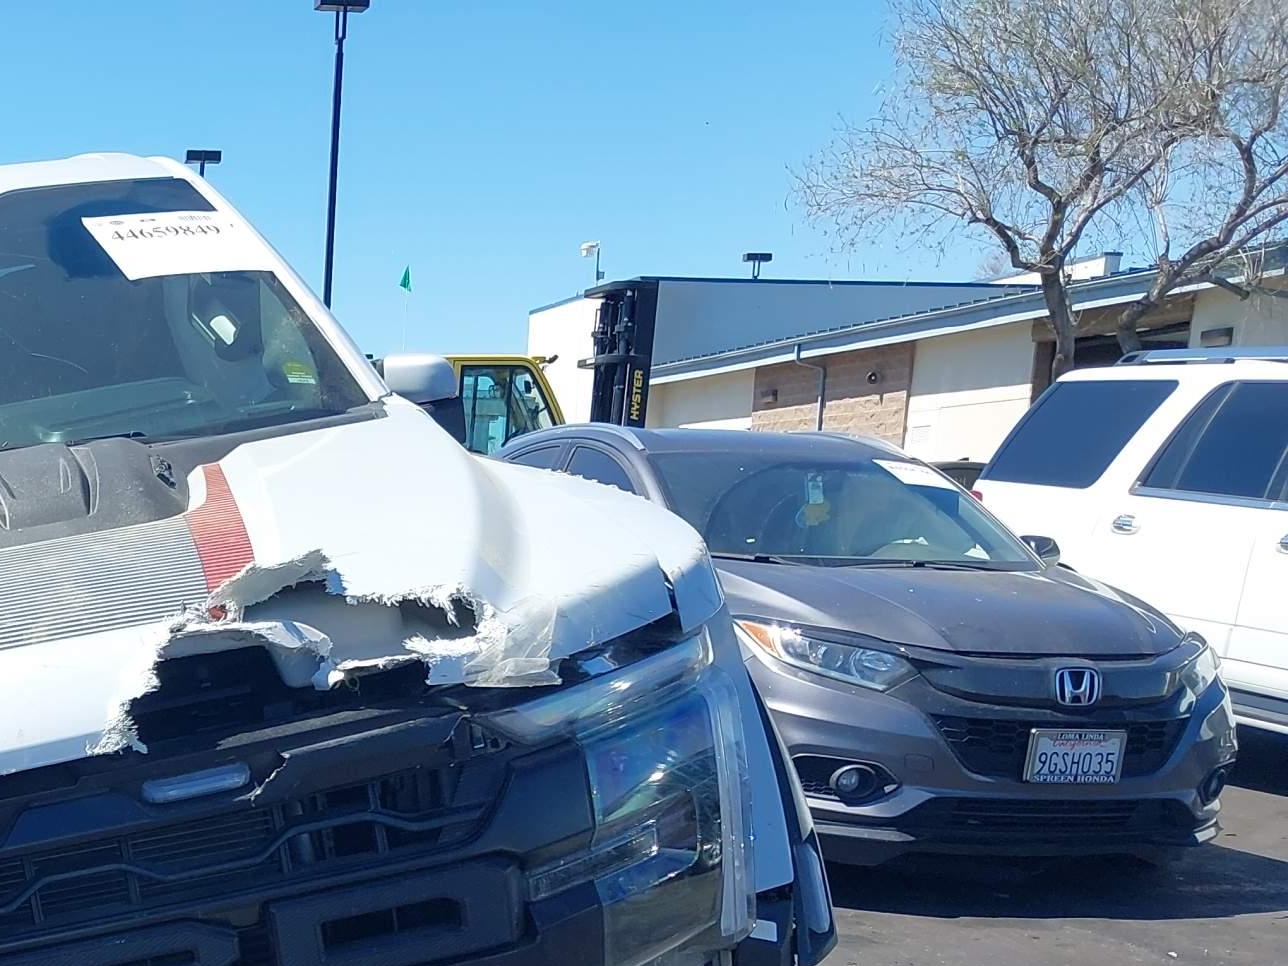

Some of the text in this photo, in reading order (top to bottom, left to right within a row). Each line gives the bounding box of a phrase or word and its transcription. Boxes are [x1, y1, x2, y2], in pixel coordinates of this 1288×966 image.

[111, 224, 220, 240] 44659849
[630, 369, 643, 420] HYSTER
[1057, 733, 1104, 741] LOMA LINDA
[1035, 751, 1114, 775] 9GSH035
[1033, 775, 1114, 783] SPREEN HONDA
